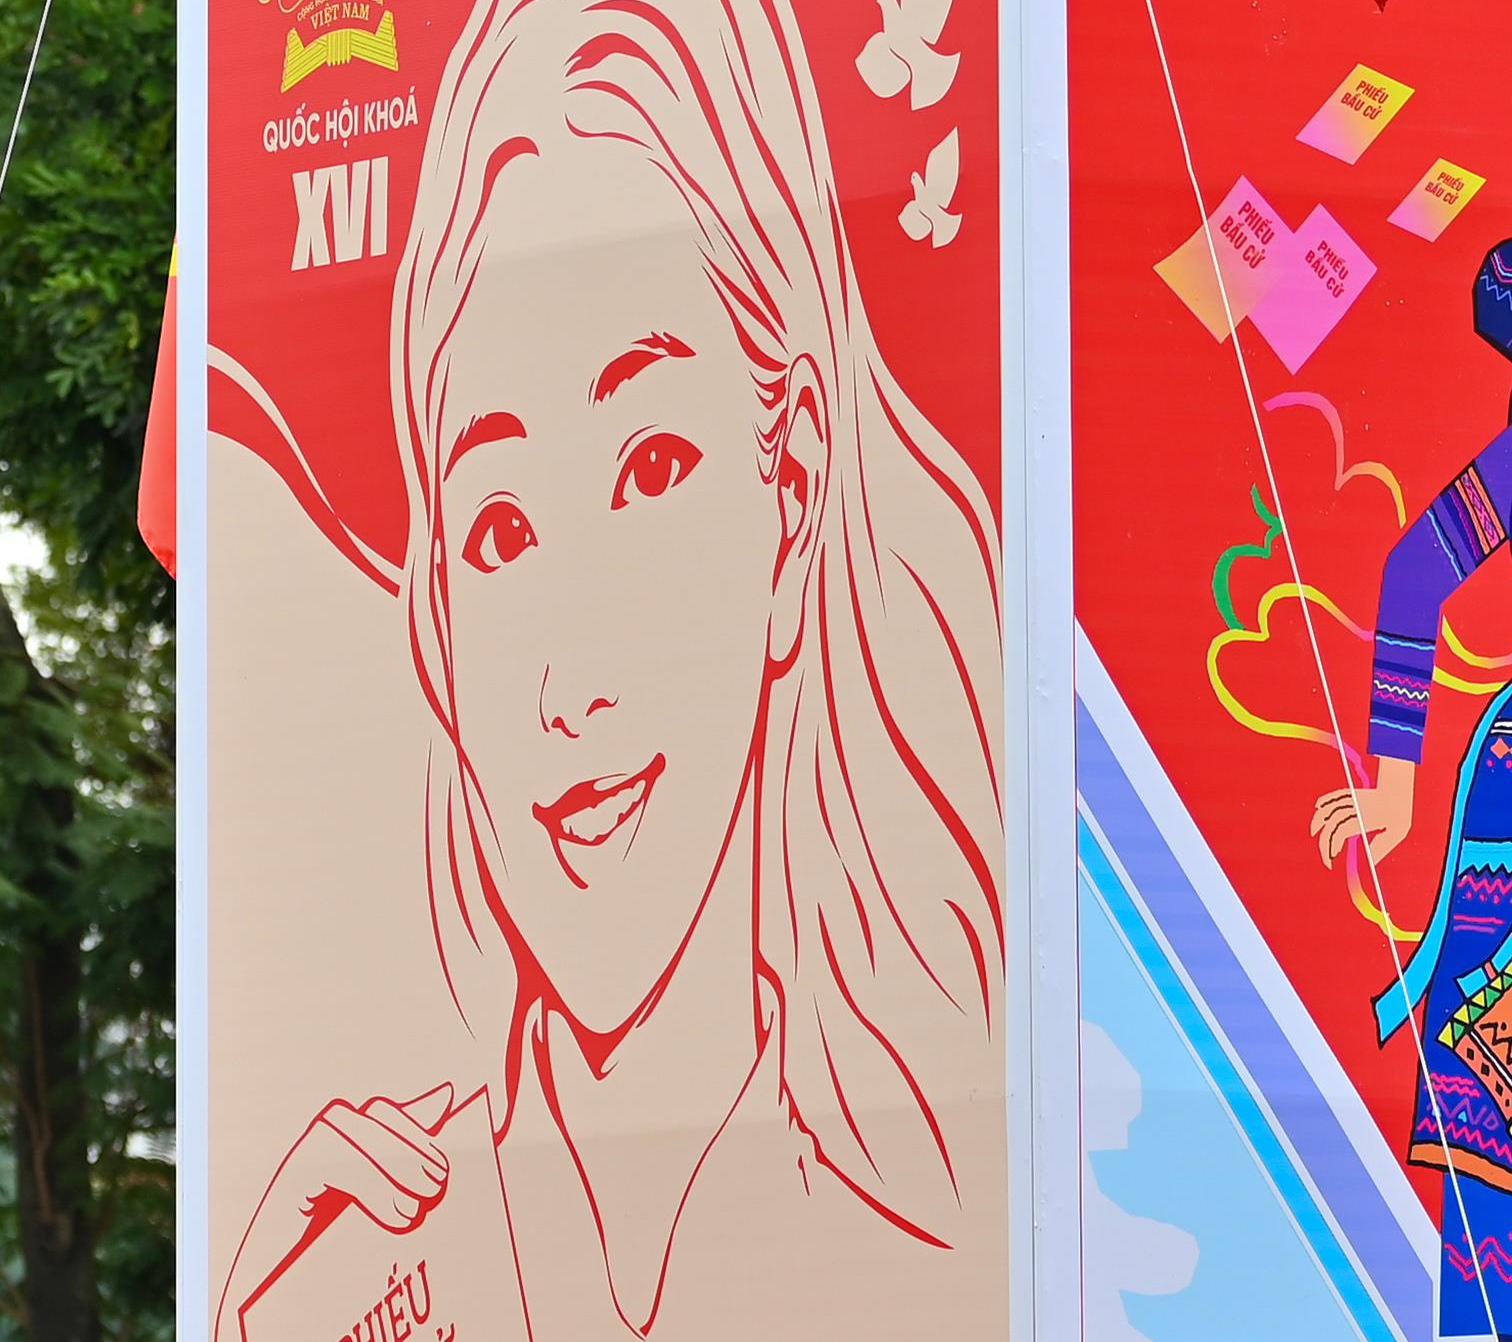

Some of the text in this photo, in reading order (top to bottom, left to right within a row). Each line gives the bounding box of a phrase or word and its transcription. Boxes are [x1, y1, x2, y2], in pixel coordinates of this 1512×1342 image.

[310, 2, 370, 30] VIỆT NAM
[1356, 80, 1389, 104] PHIẾU
[263, 85, 418, 152] QUỐC HỘI KHOÁ
[1363, 105, 1383, 120] CỬ
[291, 156, 389, 271] XVI
[1238, 200, 1275, 245] PHIẾU
[1243, 244, 1266, 269] CỬ
